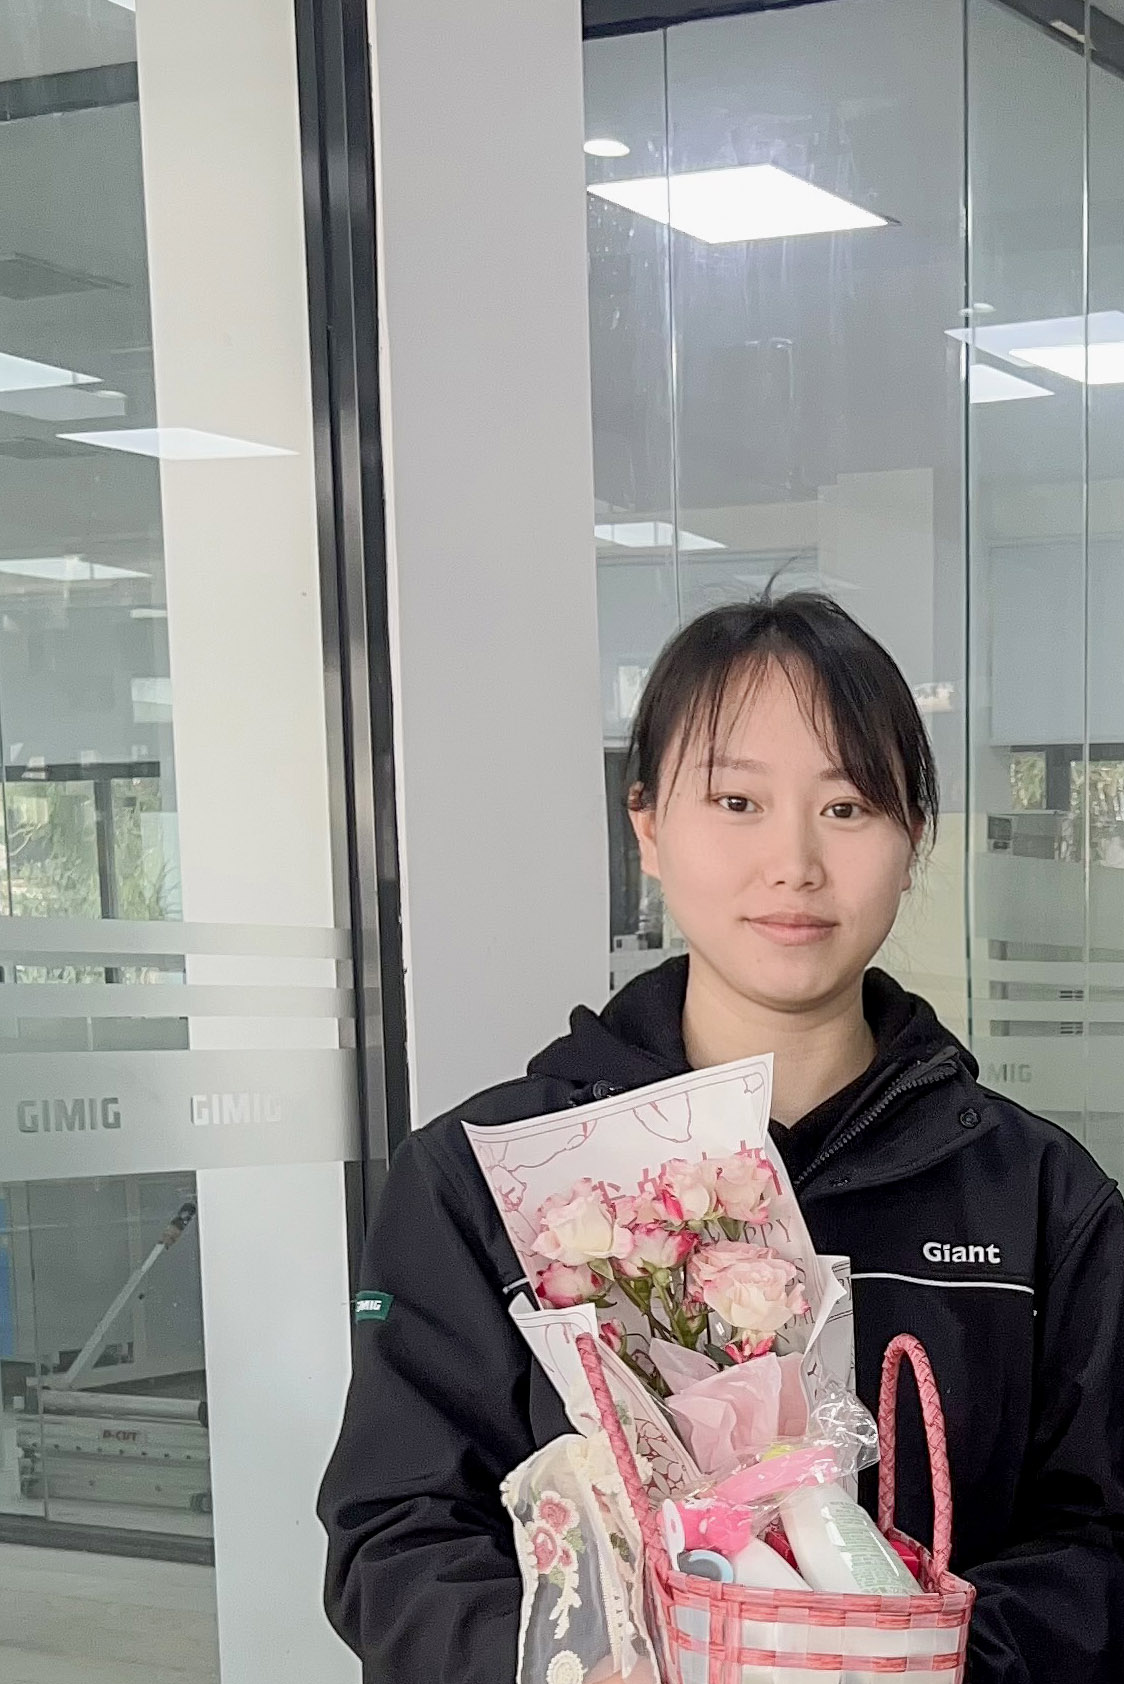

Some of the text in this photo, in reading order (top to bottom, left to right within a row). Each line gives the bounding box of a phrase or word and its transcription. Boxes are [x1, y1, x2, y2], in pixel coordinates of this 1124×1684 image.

[986, 1062, 1033, 1084] MIG
[17, 1097, 121, 1133] GIMIG
[191, 1093, 282, 1126] GIMIG
[922, 1241, 1001, 1264] Giant
